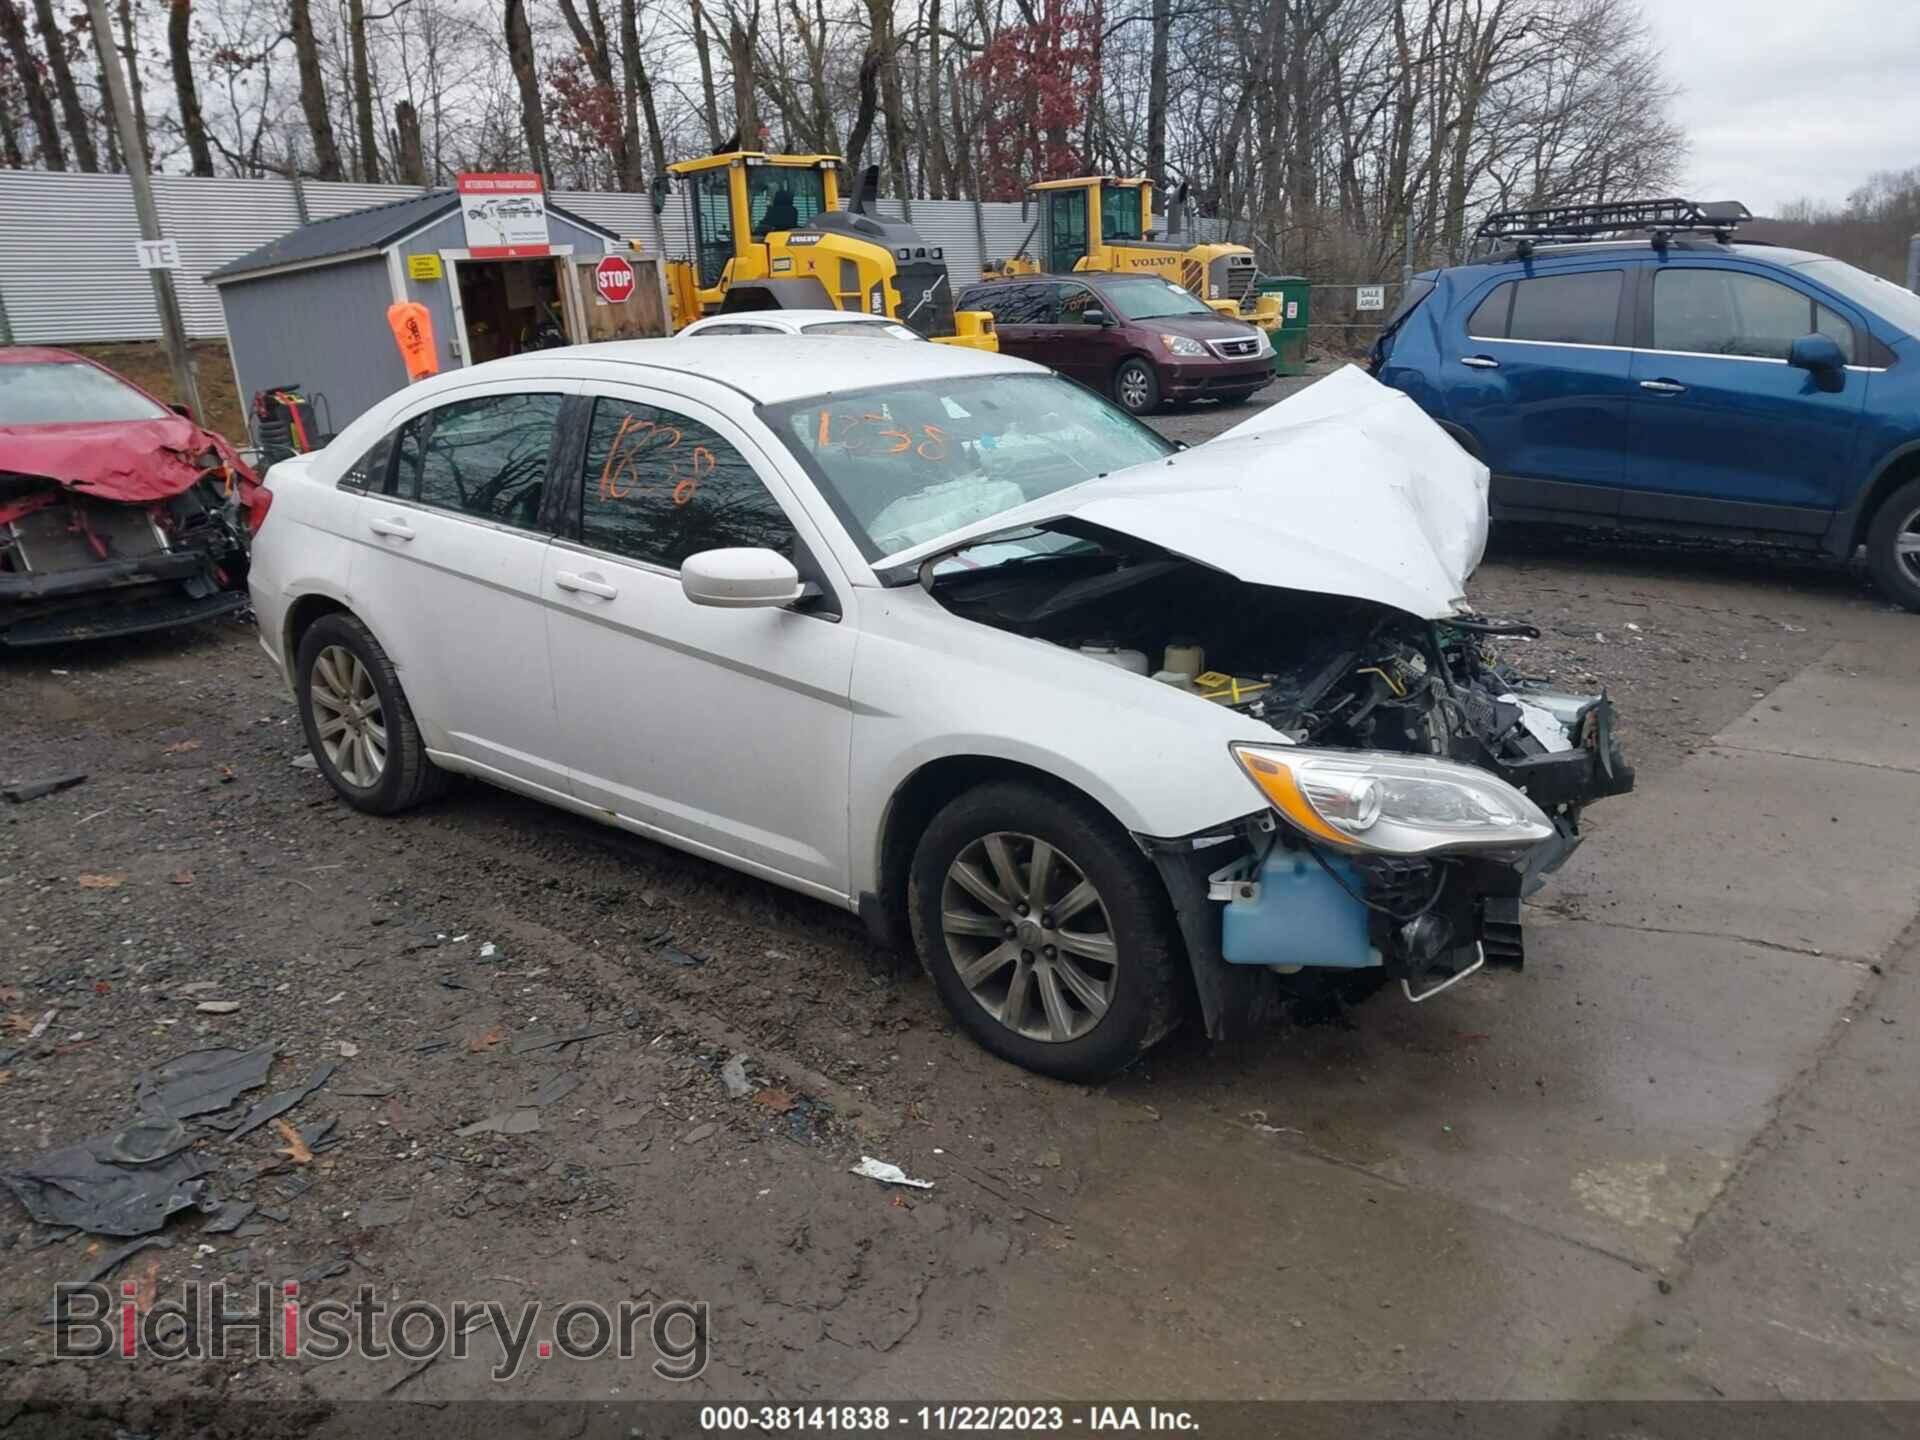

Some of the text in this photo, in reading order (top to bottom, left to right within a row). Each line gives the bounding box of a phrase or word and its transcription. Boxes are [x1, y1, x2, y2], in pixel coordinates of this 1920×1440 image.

[142, 244, 174, 265] TE
[1130, 256, 1176, 268] VOLVO
[599, 270, 631, 288] STOP
[1361, 289, 1380, 297] SALE
